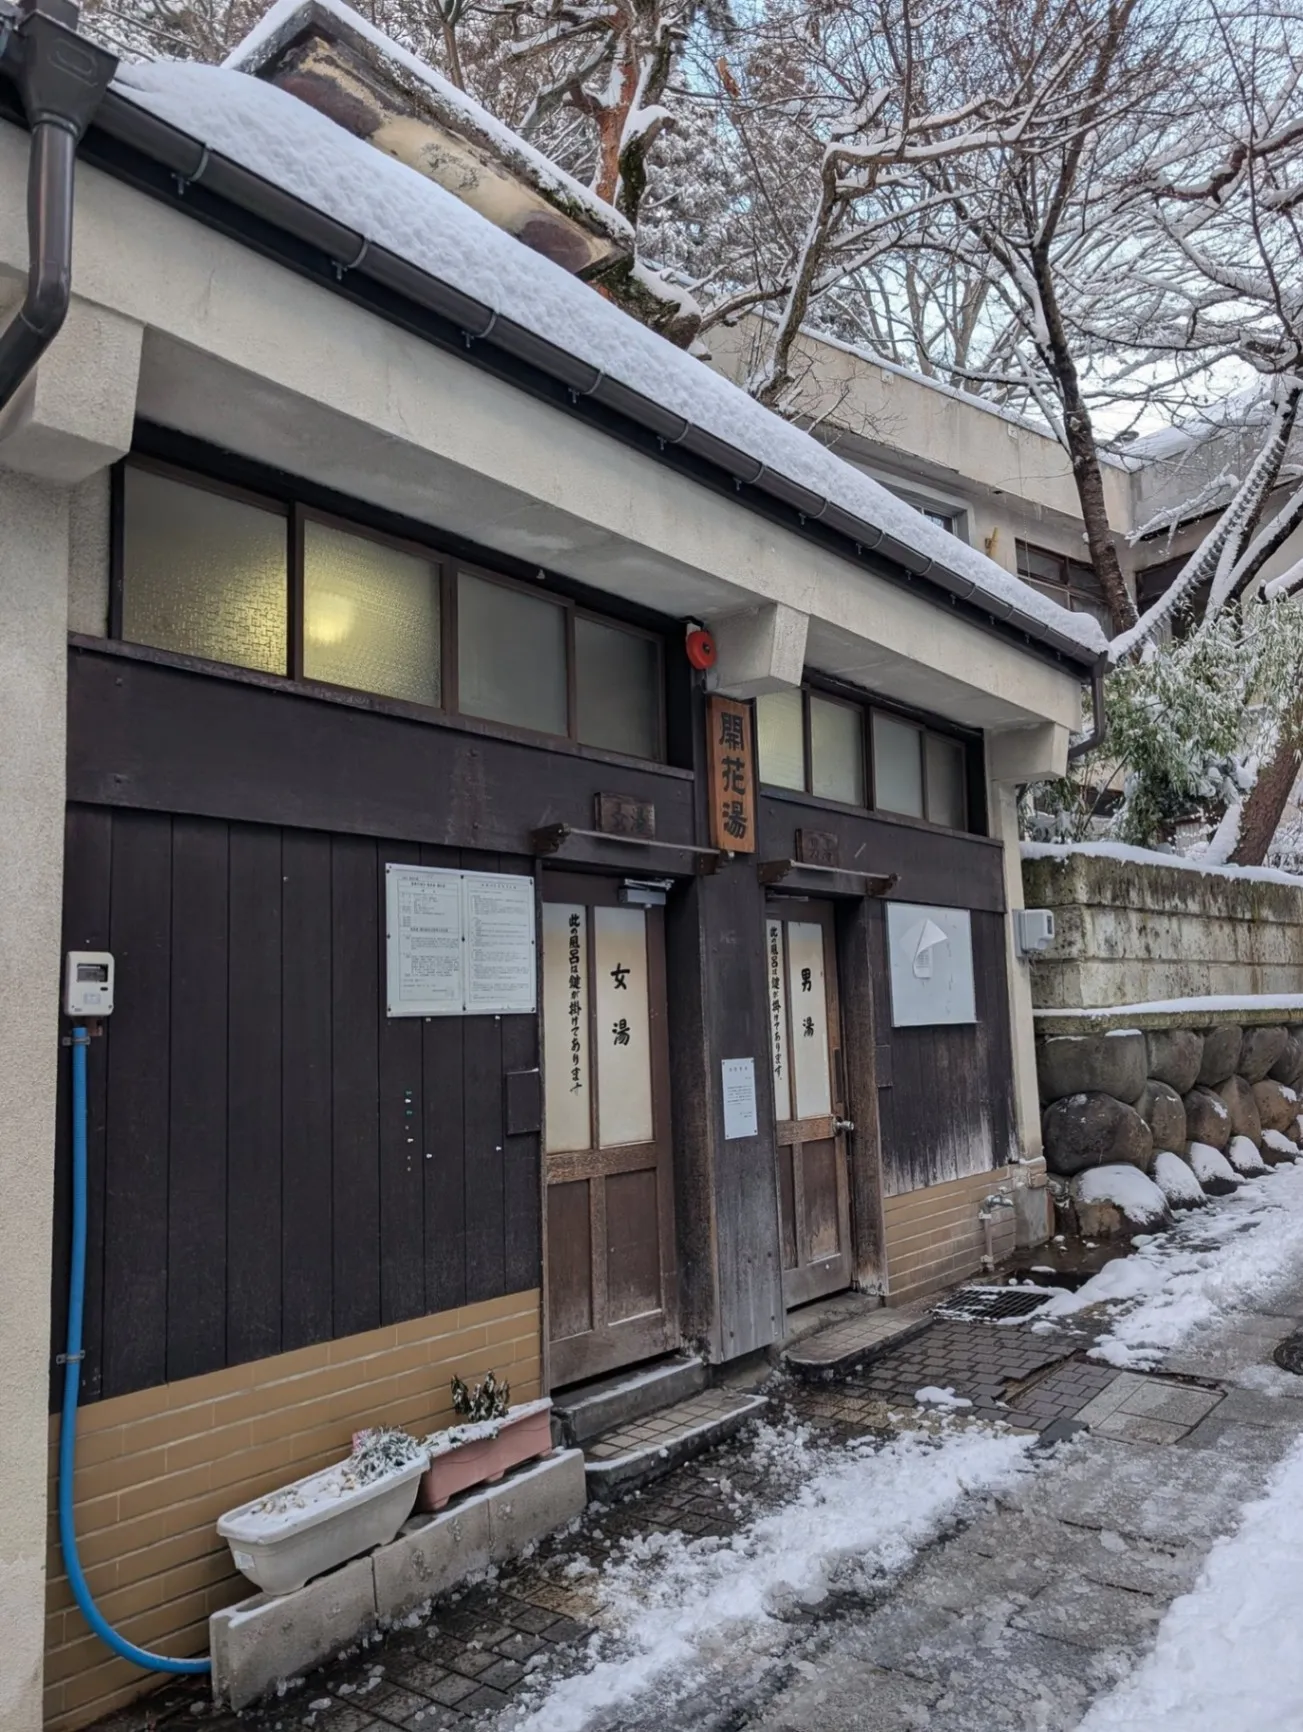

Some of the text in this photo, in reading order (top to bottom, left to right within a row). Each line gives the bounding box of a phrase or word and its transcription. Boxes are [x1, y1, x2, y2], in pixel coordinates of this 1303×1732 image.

[719, 711, 748, 839] 開花湯
[610, 962, 631, 1045] 女湯
[801, 968, 815, 1037] 男湯
